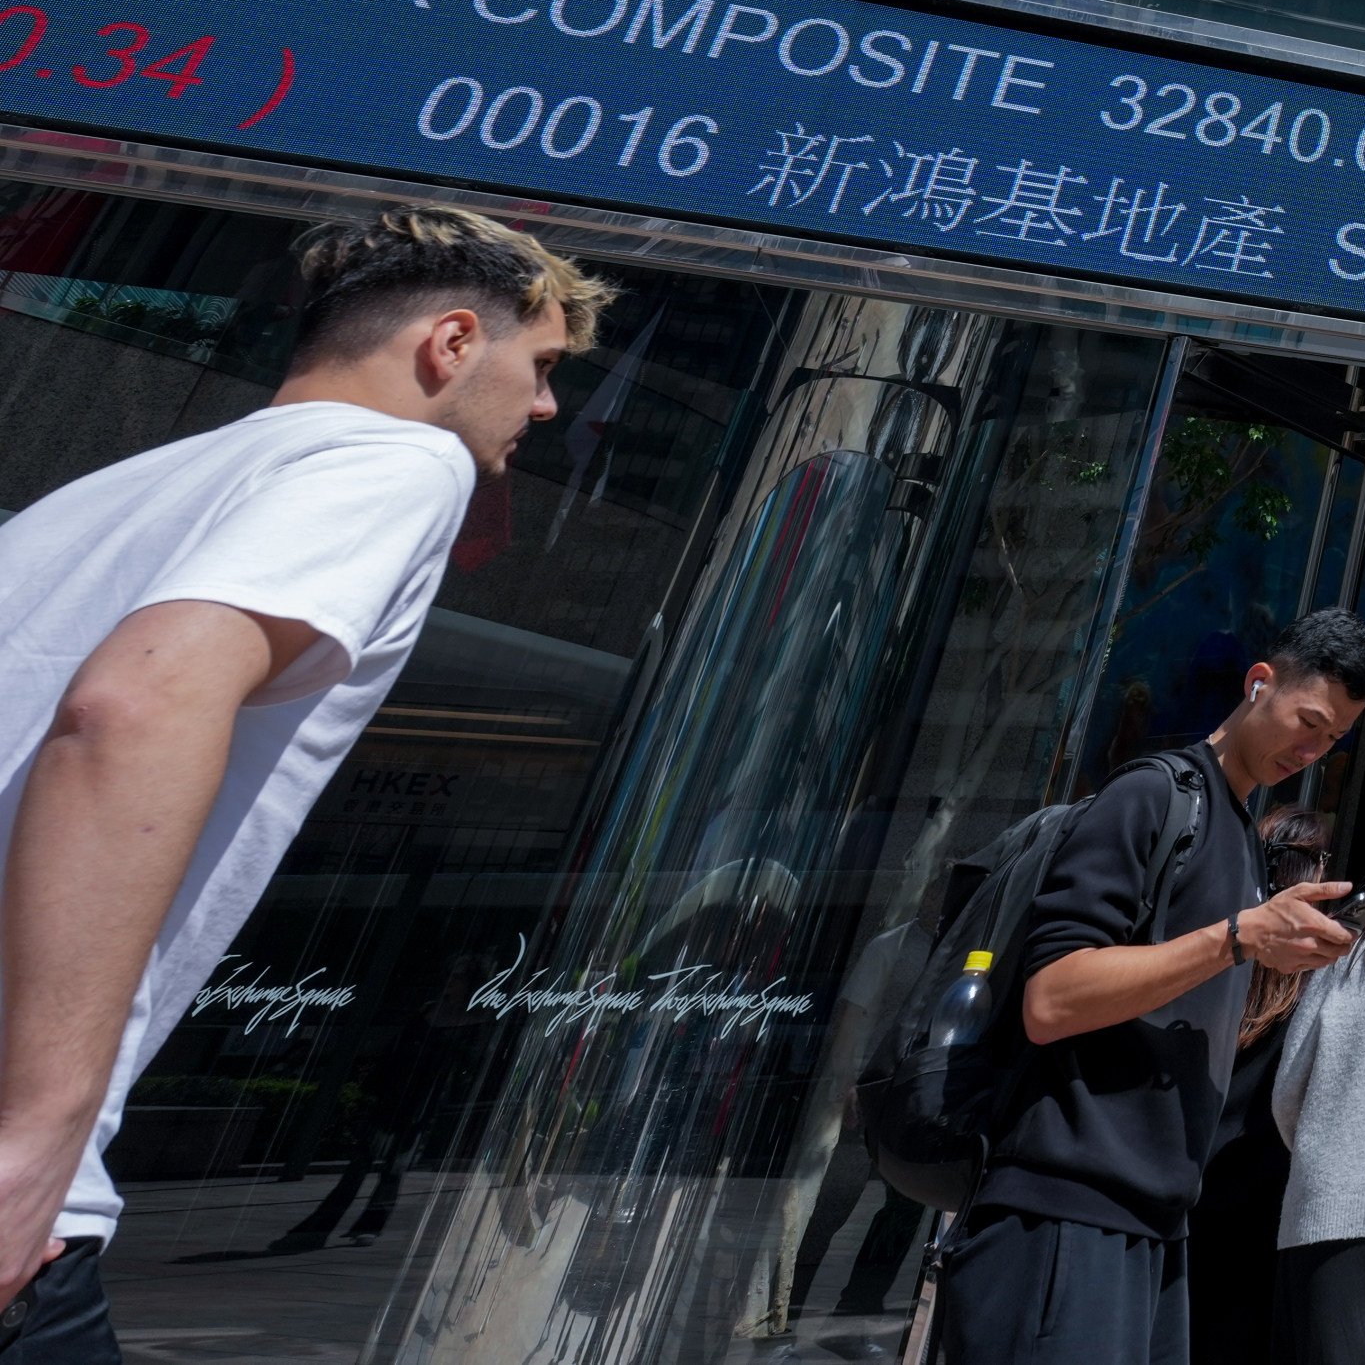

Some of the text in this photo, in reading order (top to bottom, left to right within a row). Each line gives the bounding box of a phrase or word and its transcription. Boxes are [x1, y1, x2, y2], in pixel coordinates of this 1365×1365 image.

[418, 77, 720, 178] 00016
[754, 126, 1284, 278] 新鴻基地產
